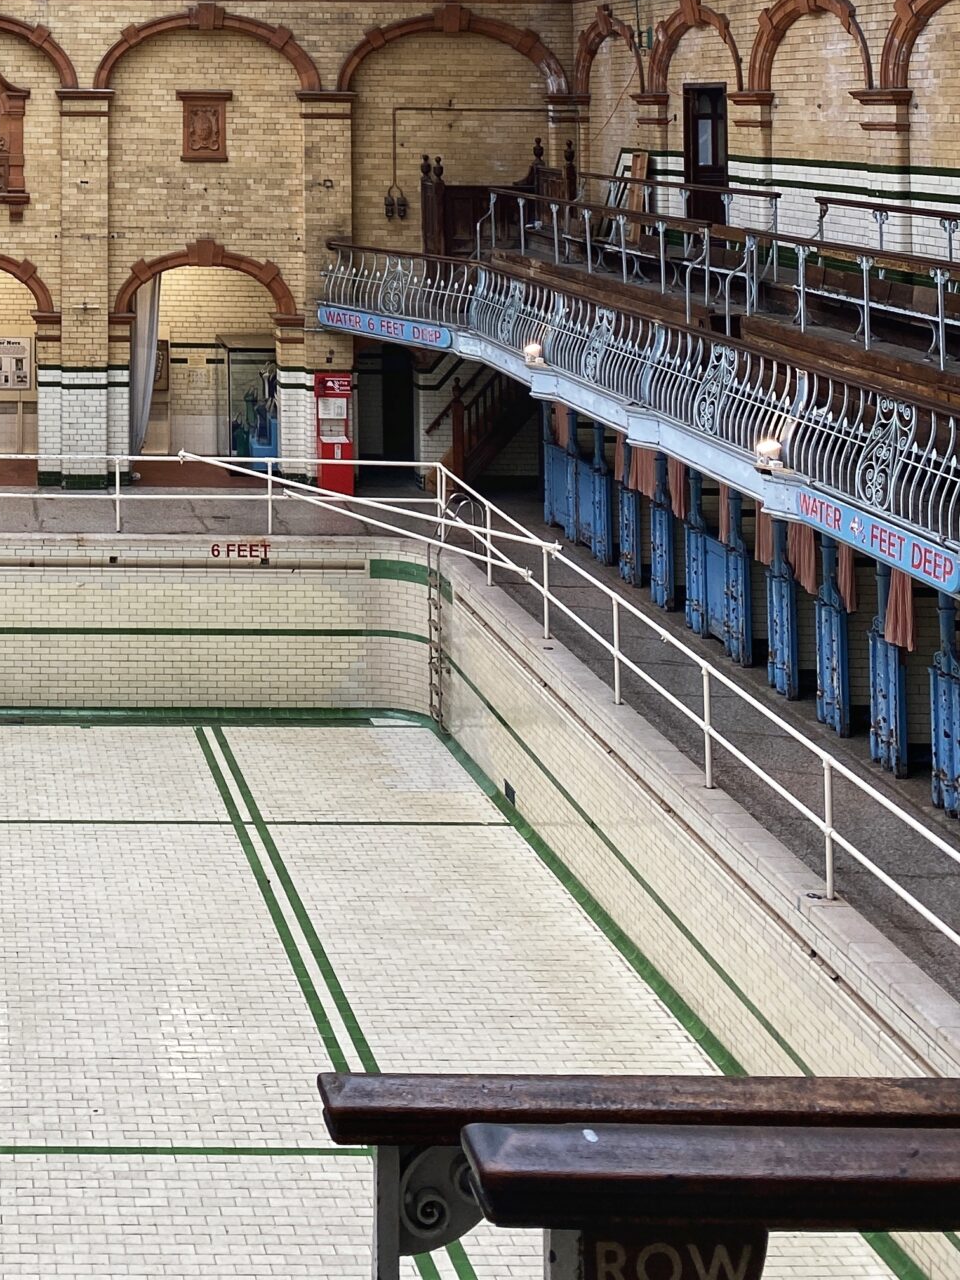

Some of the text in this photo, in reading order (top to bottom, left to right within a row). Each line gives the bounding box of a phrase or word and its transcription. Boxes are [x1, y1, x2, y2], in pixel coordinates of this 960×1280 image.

[325, 310, 441, 343] WATER 6 FEET DEEP
[211, 543, 271, 558] 6 FEET
[799, 492, 842, 531] WATER
[870, 524, 906, 562] FEET
[911, 542, 954, 583] DEEP
[595, 1240, 753, 1280] ROW
